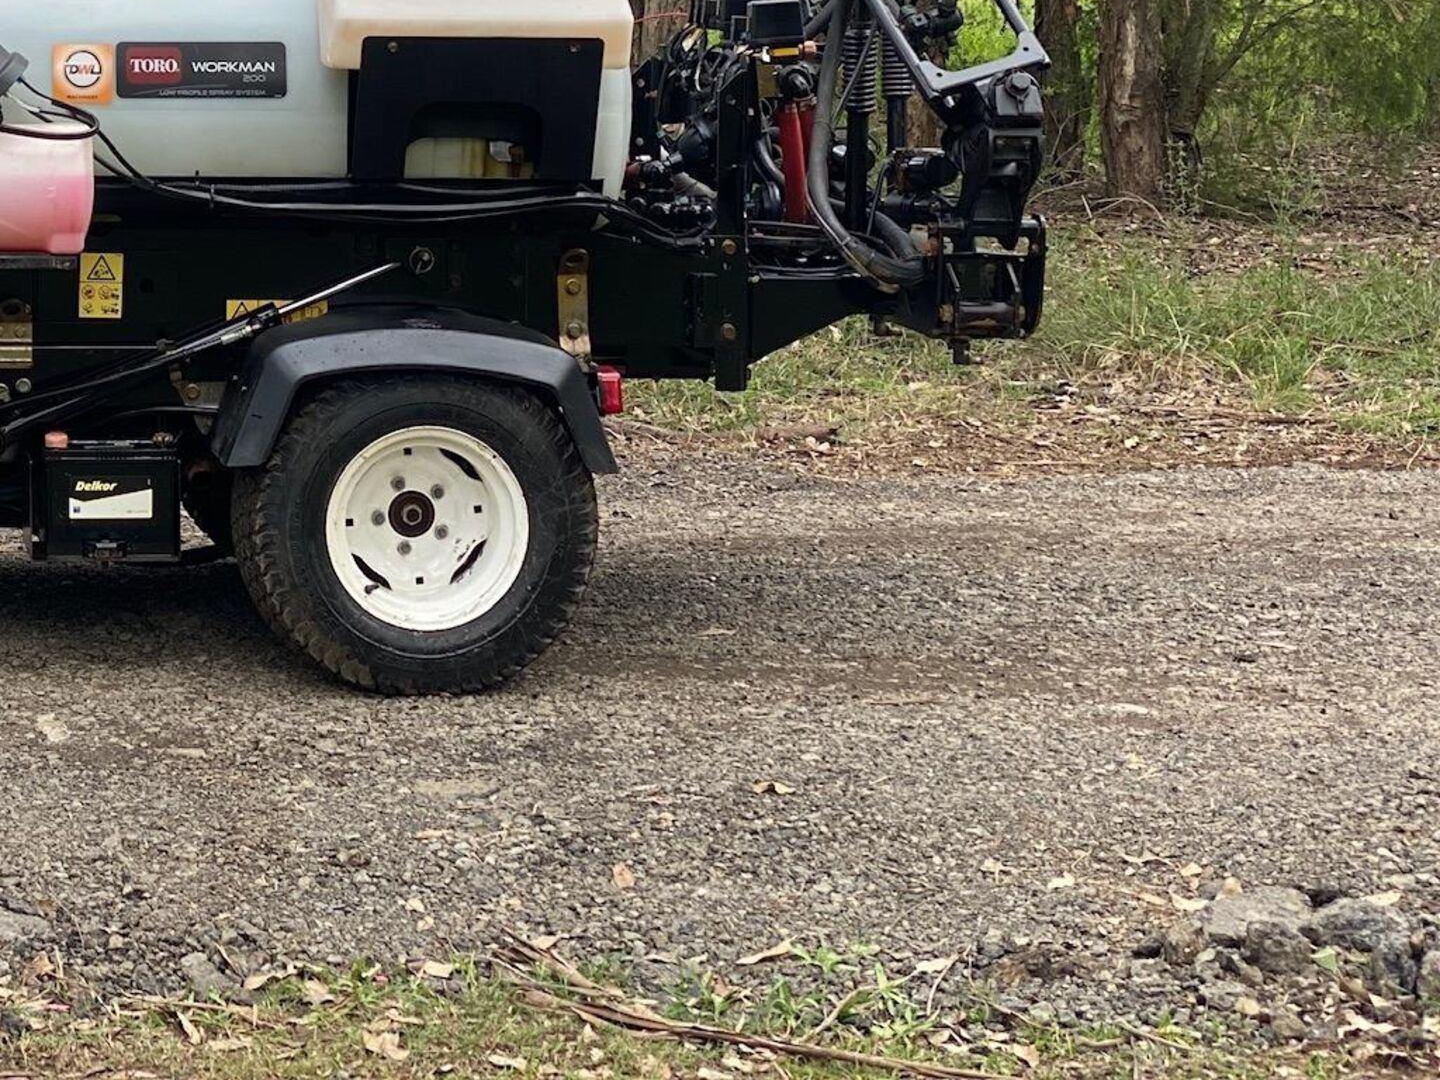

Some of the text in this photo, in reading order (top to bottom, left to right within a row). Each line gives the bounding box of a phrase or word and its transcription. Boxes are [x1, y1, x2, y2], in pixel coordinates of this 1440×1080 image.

[130, 58, 180, 73] TORO
[192, 61, 275, 73] WORKMAN
[243, 74, 266, 83] 200
[75, 481, 117, 491] Delkor
